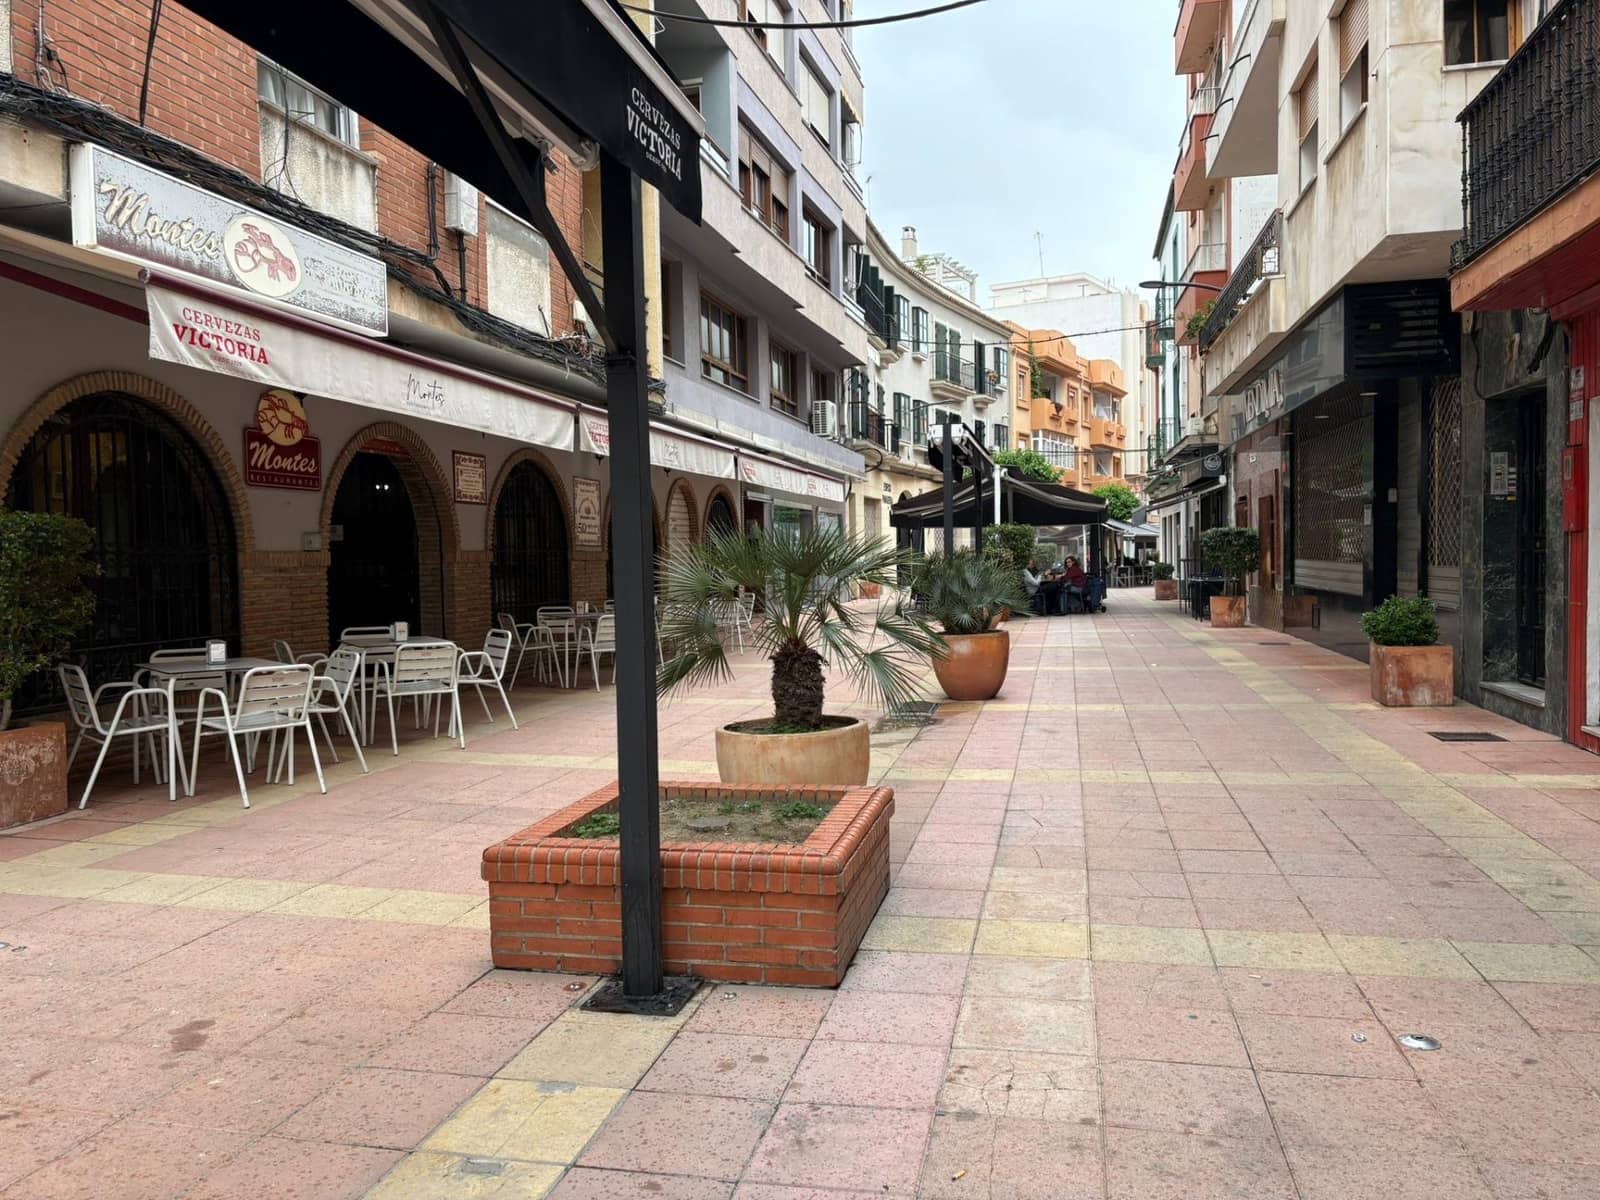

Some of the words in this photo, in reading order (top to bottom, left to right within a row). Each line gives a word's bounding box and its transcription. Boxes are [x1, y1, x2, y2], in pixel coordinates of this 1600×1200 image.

[626, 104, 682, 182] VICTORIA
[631, 87, 681, 151] CERVEZAS
[99, 179, 221, 260] Montes
[173, 323, 270, 366] VICTORIA
[182, 307, 261, 342] CERVEZAS
[249, 441, 318, 473] Montes
